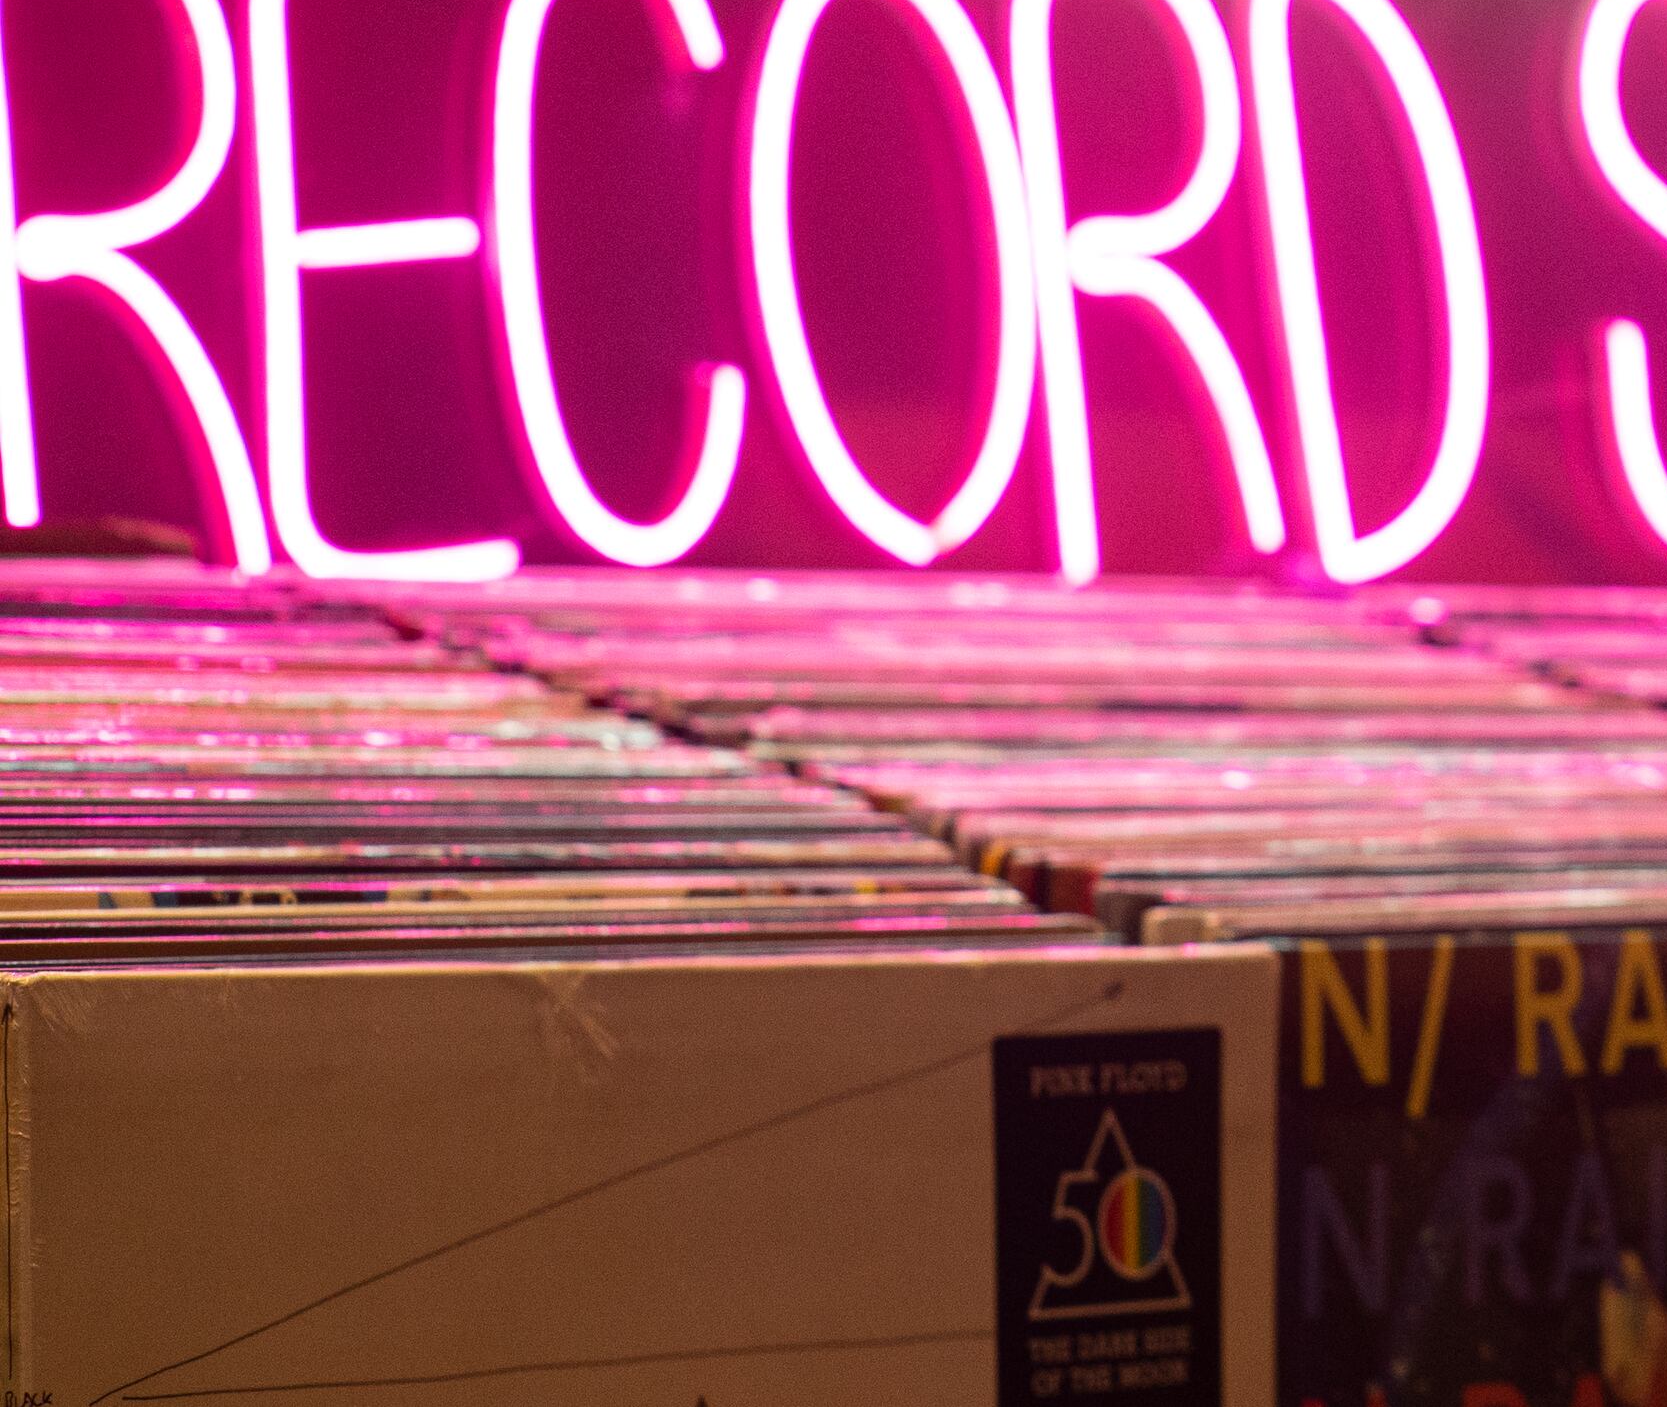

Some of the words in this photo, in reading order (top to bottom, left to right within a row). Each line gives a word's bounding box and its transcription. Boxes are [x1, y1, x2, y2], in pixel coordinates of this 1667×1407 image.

[1028, 1065, 1093, 1098] PINK
[1099, 1058, 1188, 1094] FLOYD
[1041, 1165, 1179, 1289] 50
